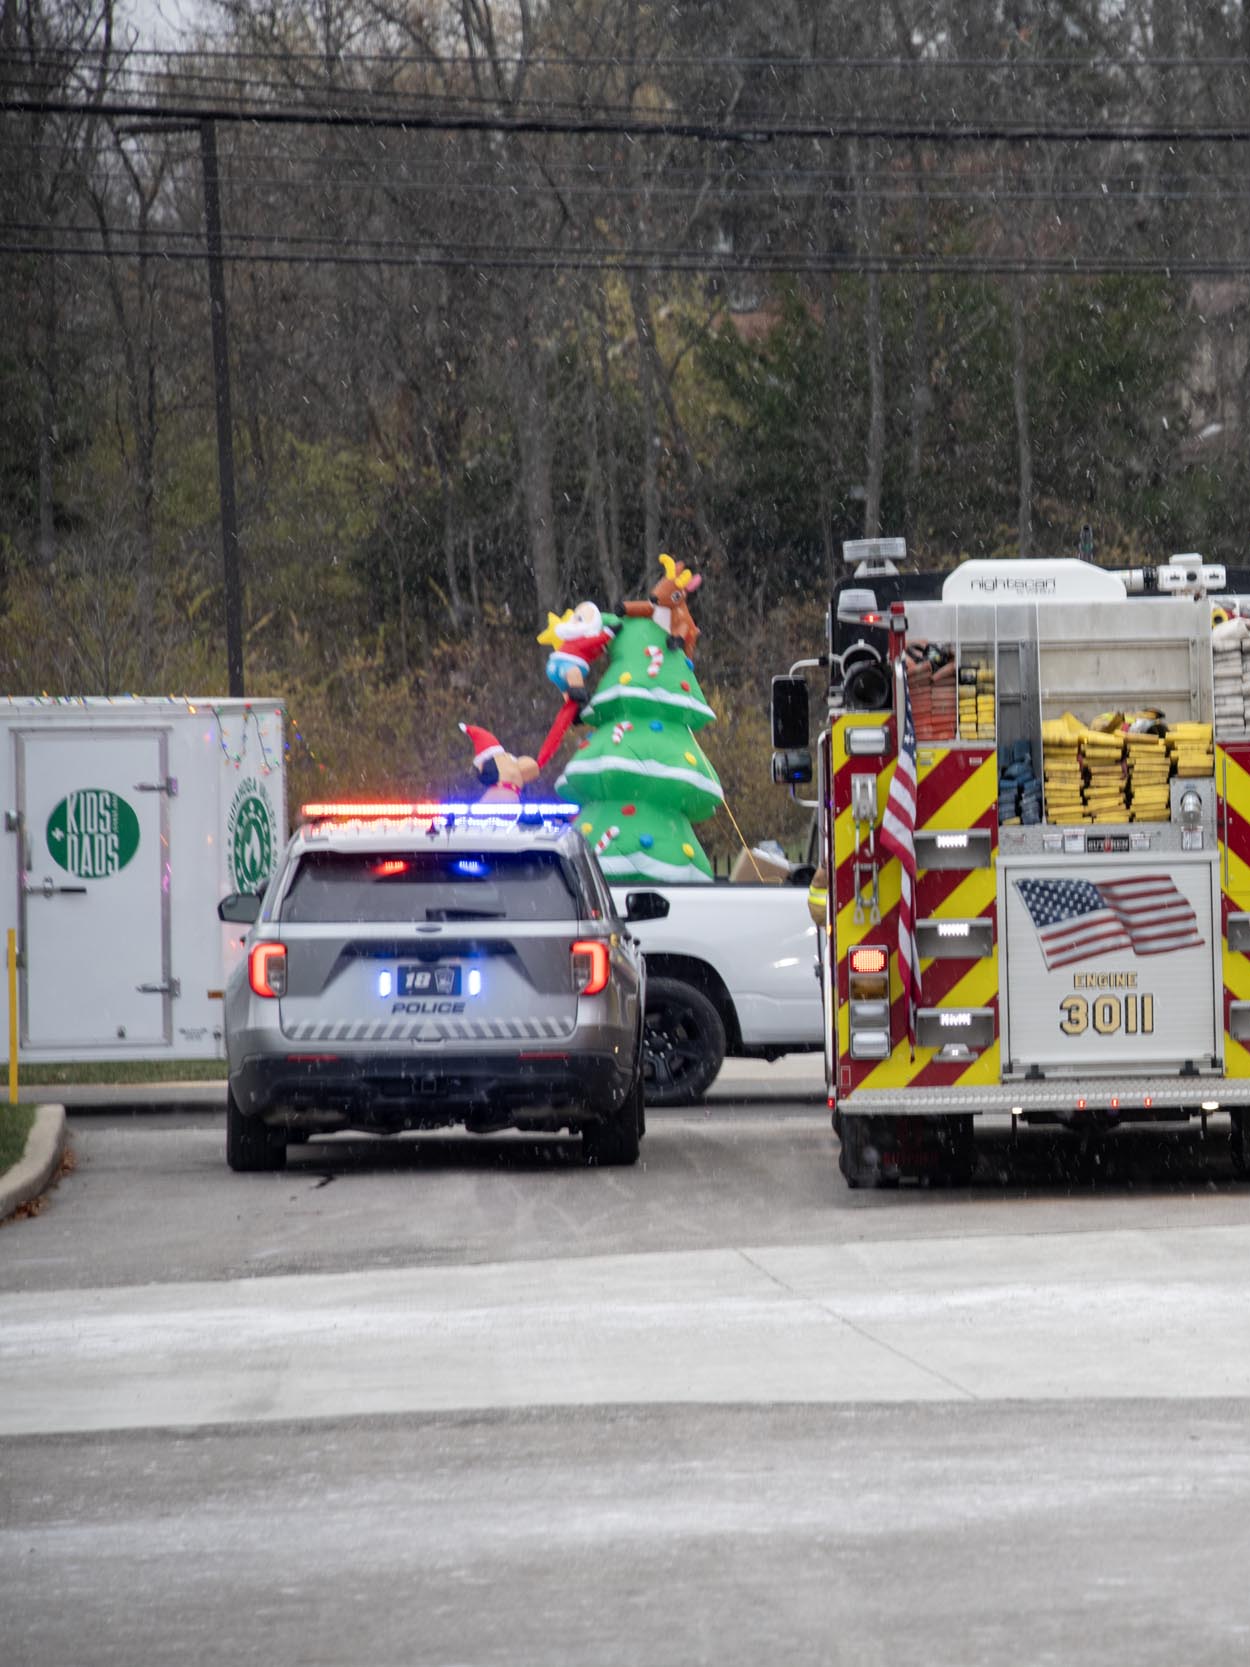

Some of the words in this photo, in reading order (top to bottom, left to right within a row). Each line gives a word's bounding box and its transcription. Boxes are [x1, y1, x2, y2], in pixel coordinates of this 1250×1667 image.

[66, 791, 112, 833] KIDS
[66, 833, 120, 877] DADS
[1073, 971, 1138, 990] ENGINE
[391, 1002, 466, 1015] POLICE
[1059, 993, 1154, 1036] 3011
